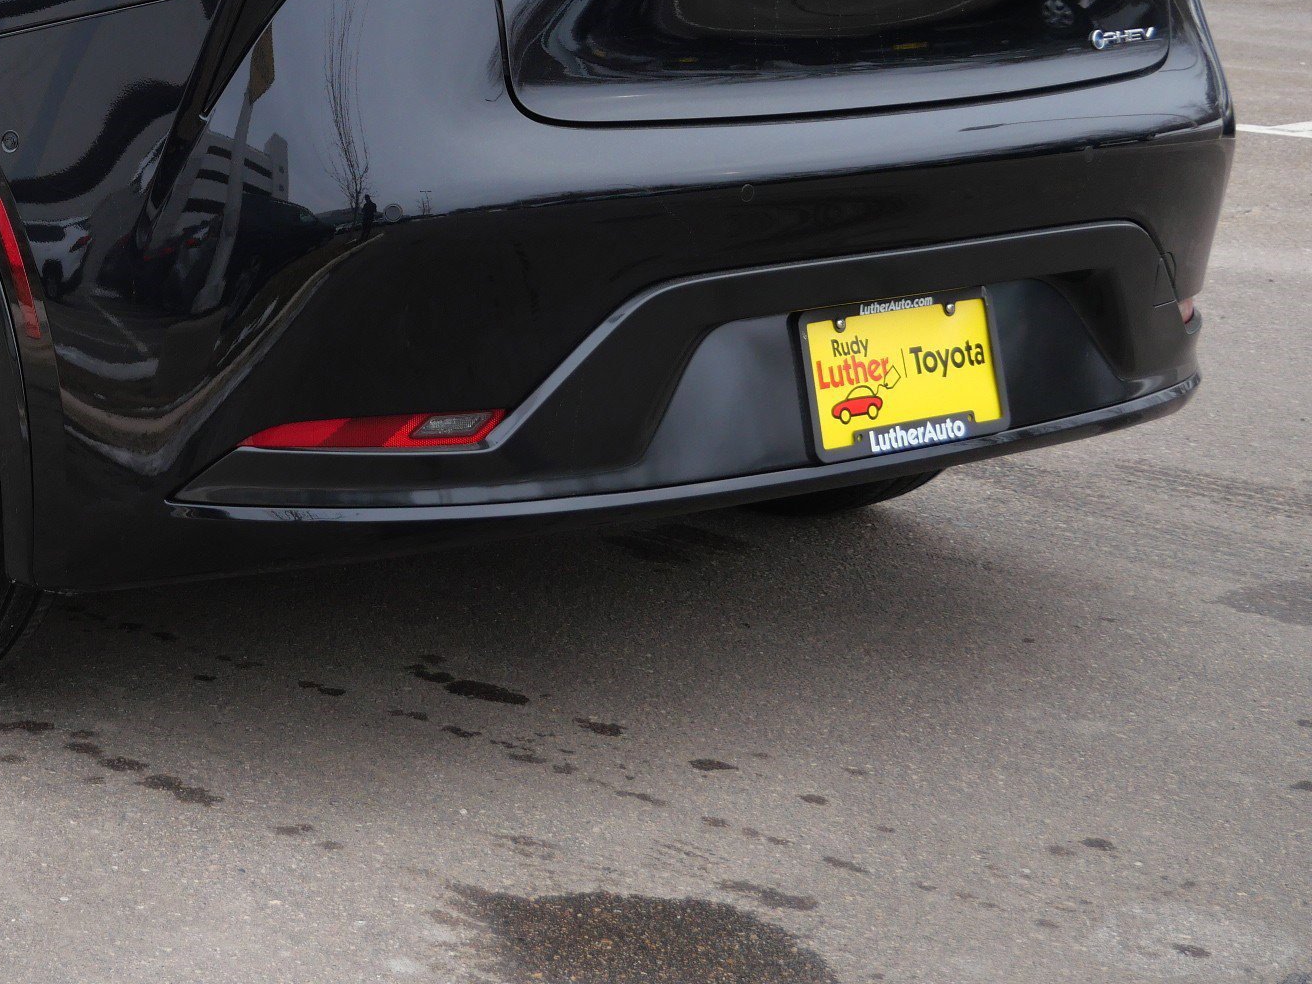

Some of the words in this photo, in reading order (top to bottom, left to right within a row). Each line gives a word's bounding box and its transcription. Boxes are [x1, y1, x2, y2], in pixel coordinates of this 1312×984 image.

[1103, 26, 1156, 44] PHEV
[859, 296, 933, 315] LutherAuto.com
[831, 335, 869, 357] Rudy
[816, 355, 889, 390] Luther
[909, 340, 986, 377] Toyota
[869, 418, 965, 452] LutherAuto
